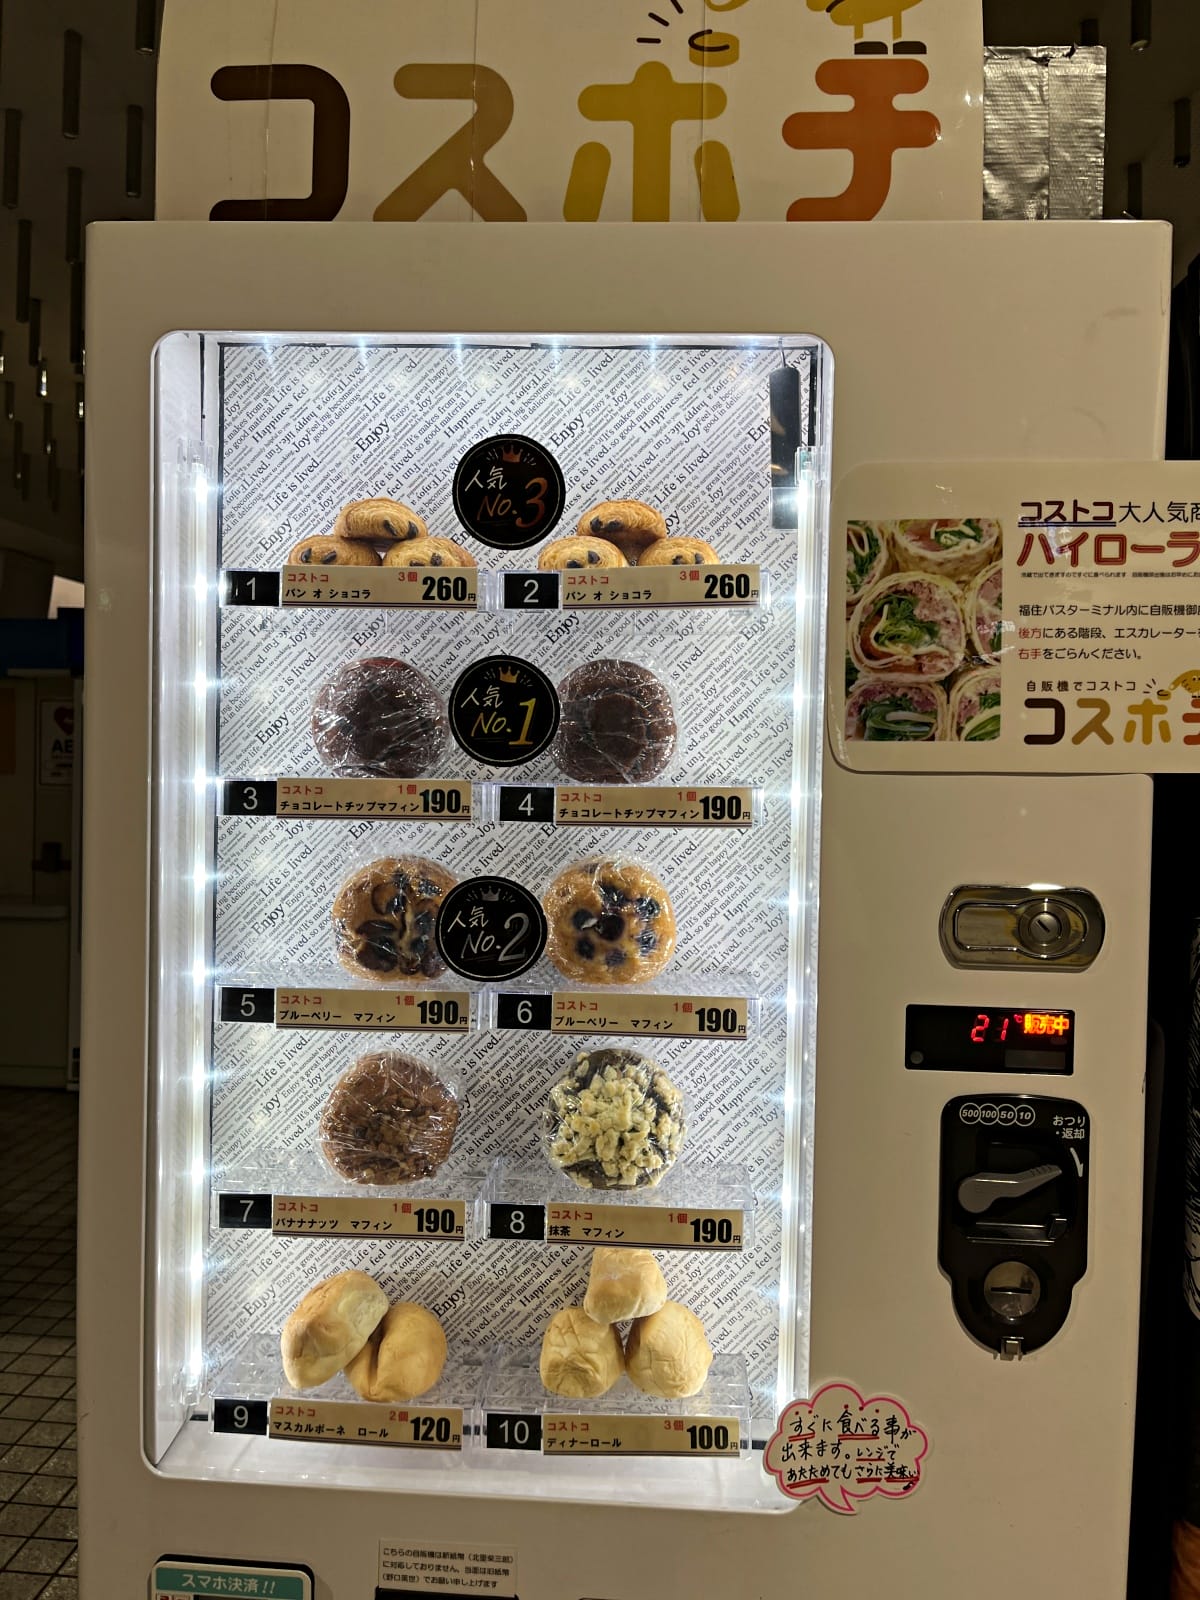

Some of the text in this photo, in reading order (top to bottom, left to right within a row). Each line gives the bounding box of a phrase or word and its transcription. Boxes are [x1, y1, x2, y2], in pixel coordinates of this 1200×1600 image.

[355, 417, 392, 452] Enjoy
[549, 412, 587, 448] Enjoy
[267, 456, 322, 511] Life is lived.
[465, 466, 507, 492] 人気
[653, 446, 712, 503] Life is lived.
[258, 517, 295, 552] Enjoy
[247, 577, 257, 600] 1
[287, 572, 329, 583] コストコ
[313, 588, 322, 598] オ
[329, 588, 371, 599] ショコラ
[422, 576, 476, 601] 260円
[567, 575, 609, 586] コストコ
[593, 591, 602, 600] オ
[610, 589, 652, 600] ショコラ
[704, 573, 759, 599] 260円
[523, 579, 539, 603] 2
[546, 612, 581, 645] Enjoy
[1018, 648, 1143, 660] 右手をごらんください。
[461, 685, 503, 708] 人気
[1026, 680, 1137, 692] 自販機でコストコ
[255, 711, 289, 745] Enjoy
[243, 787, 258, 810] 3
[280, 789, 470, 814] チョコレートチップマフィン 190円
[282, 784, 324, 795] コストコ
[560, 792, 602, 803] コストコ
[518, 792, 534, 816] 4
[559, 796, 751, 820] チョコレートチップマフィン 190円
[251, 903, 286, 936] Enjoy
[447, 906, 488, 932] 人気
[240, 994, 256, 1016] 5
[279, 1000, 468, 1025] ブルーベリー マフィン 190円
[280, 995, 322, 1006] コストコ
[517, 1000, 533, 1024] 6
[556, 1001, 599, 1012] コストコ
[555, 1007, 746, 1034] ブルーベリー マフィン 190円
[1024, 1013, 1070, 1036] 販売中
[961, 1109, 1031, 1120] 500 100 50 10
[1053, 1115, 1085, 1126] おつり
[239, 1200, 255, 1223] 7
[278, 1203, 319, 1214] コストコ
[551, 1210, 593, 1221] コストコ
[350, 1221, 392, 1231] マフィン
[413, 1208, 464, 1234] 190円
[509, 1210, 526, 1234] 8
[549, 1218, 741, 1244] 抹茶 マフィン 190円
[520, 1268, 561, 1307] Happiness
[432, 1284, 467, 1317] Enjoy
[233, 1405, 249, 1428] 9
[275, 1406, 316, 1417] コストコ
[358, 1428, 388, 1438] ロール
[410, 1417, 461, 1443] 120円
[499, 1419, 530, 1444] 10
[547, 1420, 590, 1431] コストコ
[547, 1425, 738, 1449] ディナーロール 100円
